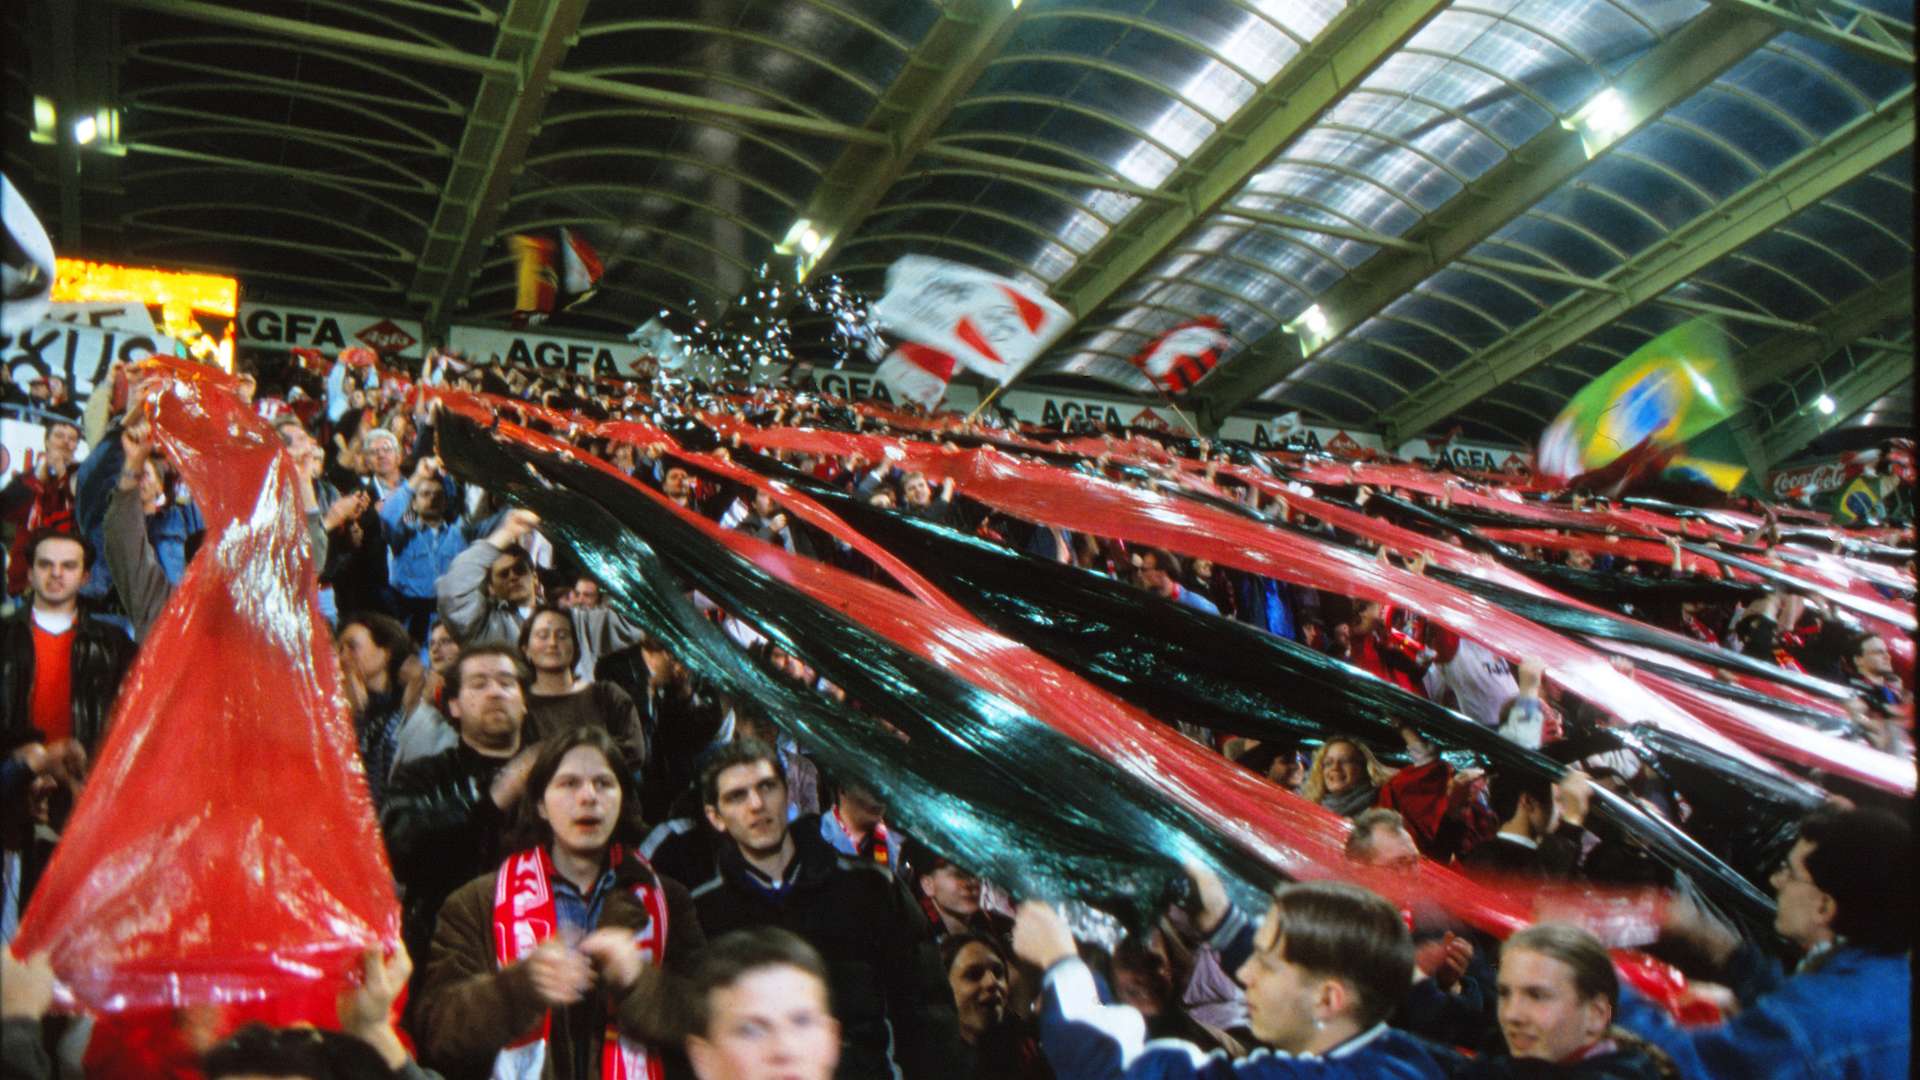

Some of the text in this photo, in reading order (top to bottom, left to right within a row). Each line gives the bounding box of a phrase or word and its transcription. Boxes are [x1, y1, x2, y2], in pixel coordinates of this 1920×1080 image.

[505, 338, 621, 377] AGFA
[1041, 399, 1122, 430] AGFA
[1253, 423, 1321, 452] AA
[1436, 448, 1498, 473] AGFA
